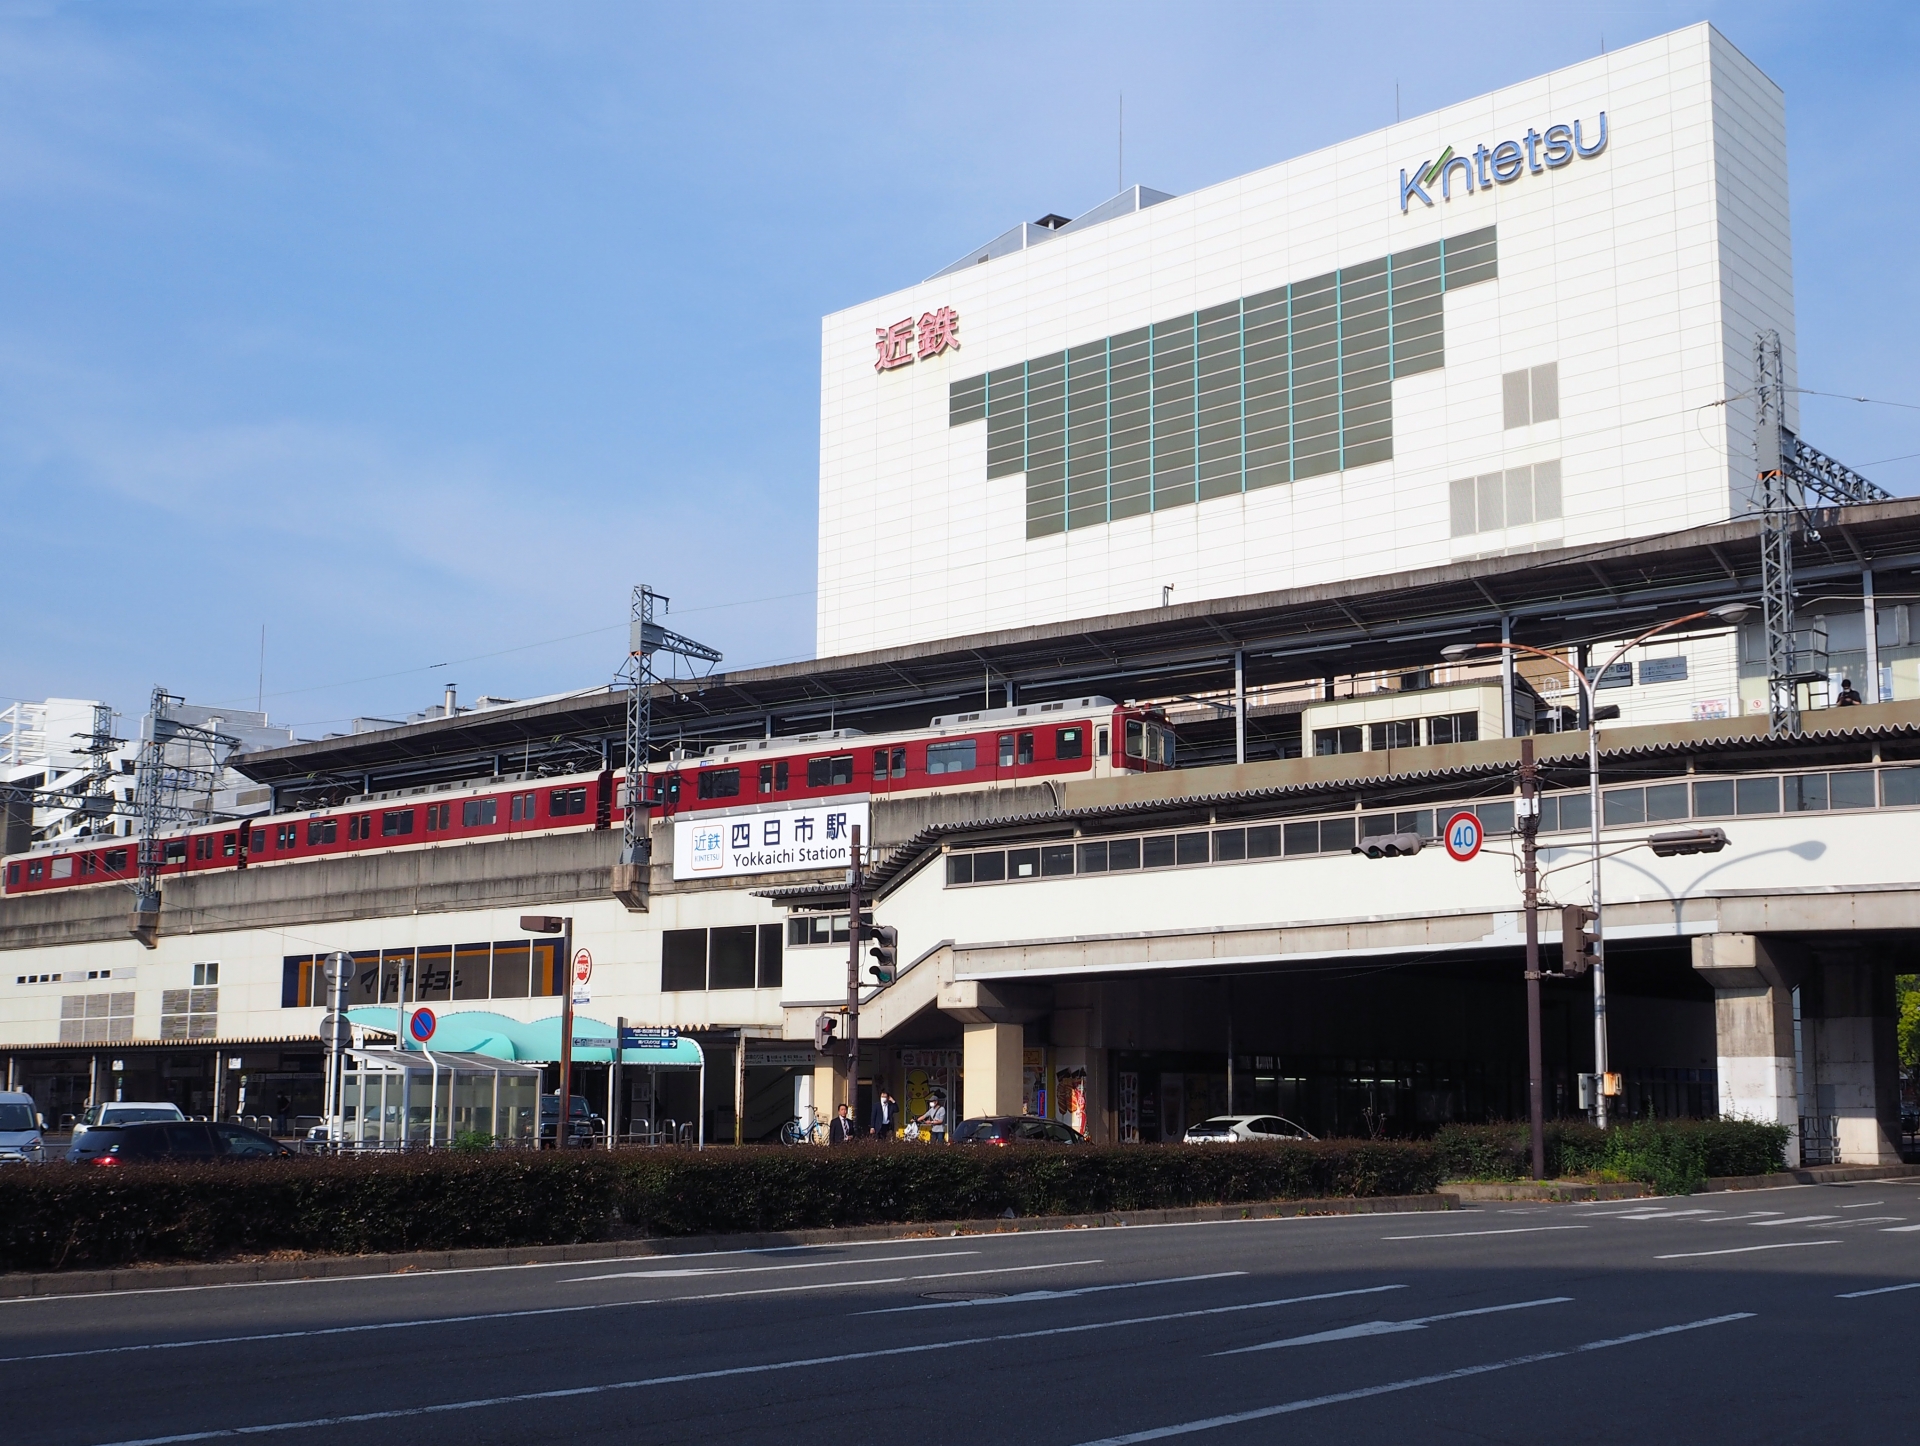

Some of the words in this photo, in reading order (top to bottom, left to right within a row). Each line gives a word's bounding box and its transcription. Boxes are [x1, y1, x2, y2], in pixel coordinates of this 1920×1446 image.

[1400, 111, 1608, 211] Kintetsu
[874, 305, 959, 372] 近鉄
[731, 812, 847, 849] 四日市駅
[1453, 826, 1474, 848] 40
[694, 833, 721, 851] 近鉄
[694, 853, 720, 862] KINTETSU
[733, 849, 794, 867] Yokkaichi
[799, 847, 846, 862] Station
